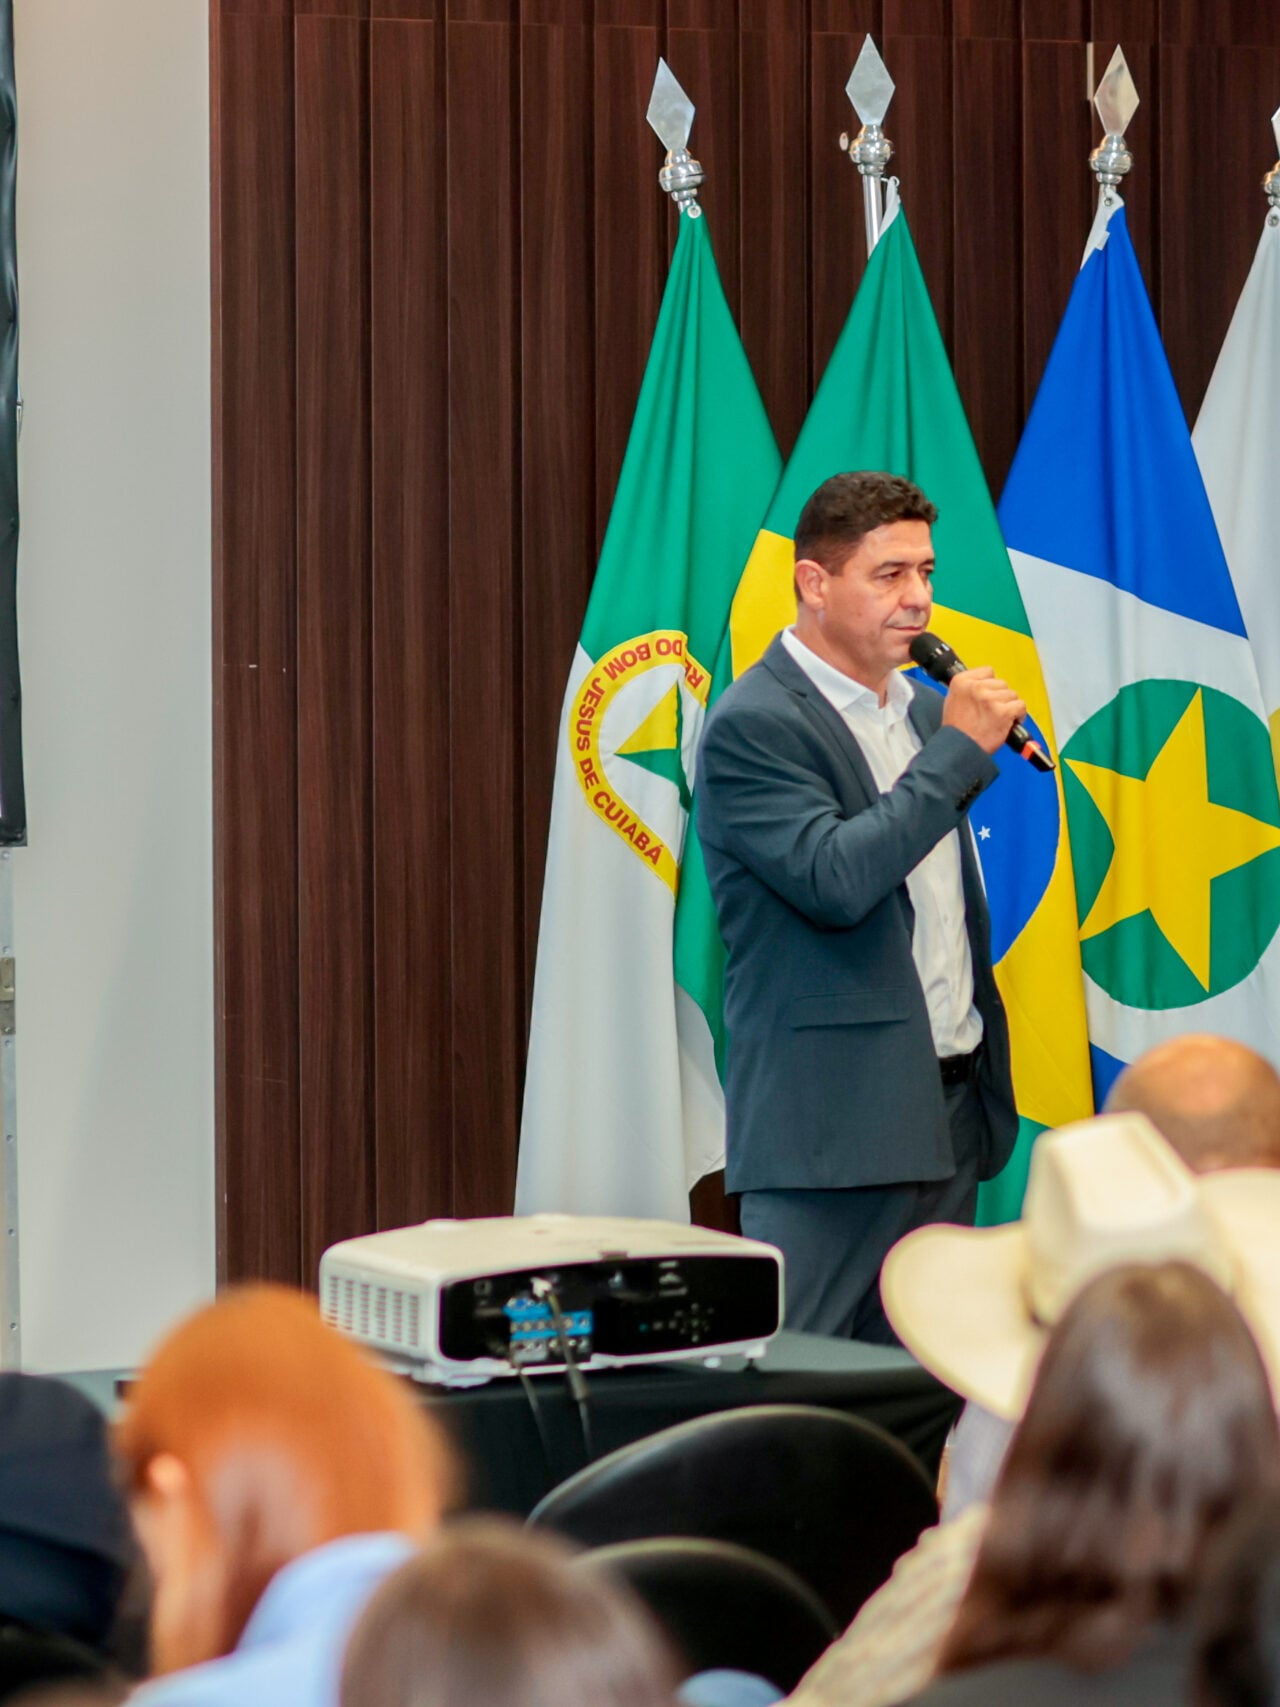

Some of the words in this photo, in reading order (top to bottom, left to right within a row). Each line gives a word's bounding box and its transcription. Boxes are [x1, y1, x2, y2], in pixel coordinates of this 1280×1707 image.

[602, 642, 652, 681] BOM
[655, 638, 683, 657] DO
[575, 677, 605, 753] JESUS
[578, 757, 601, 790] DE
[592, 790, 664, 867] CUIABÁ
